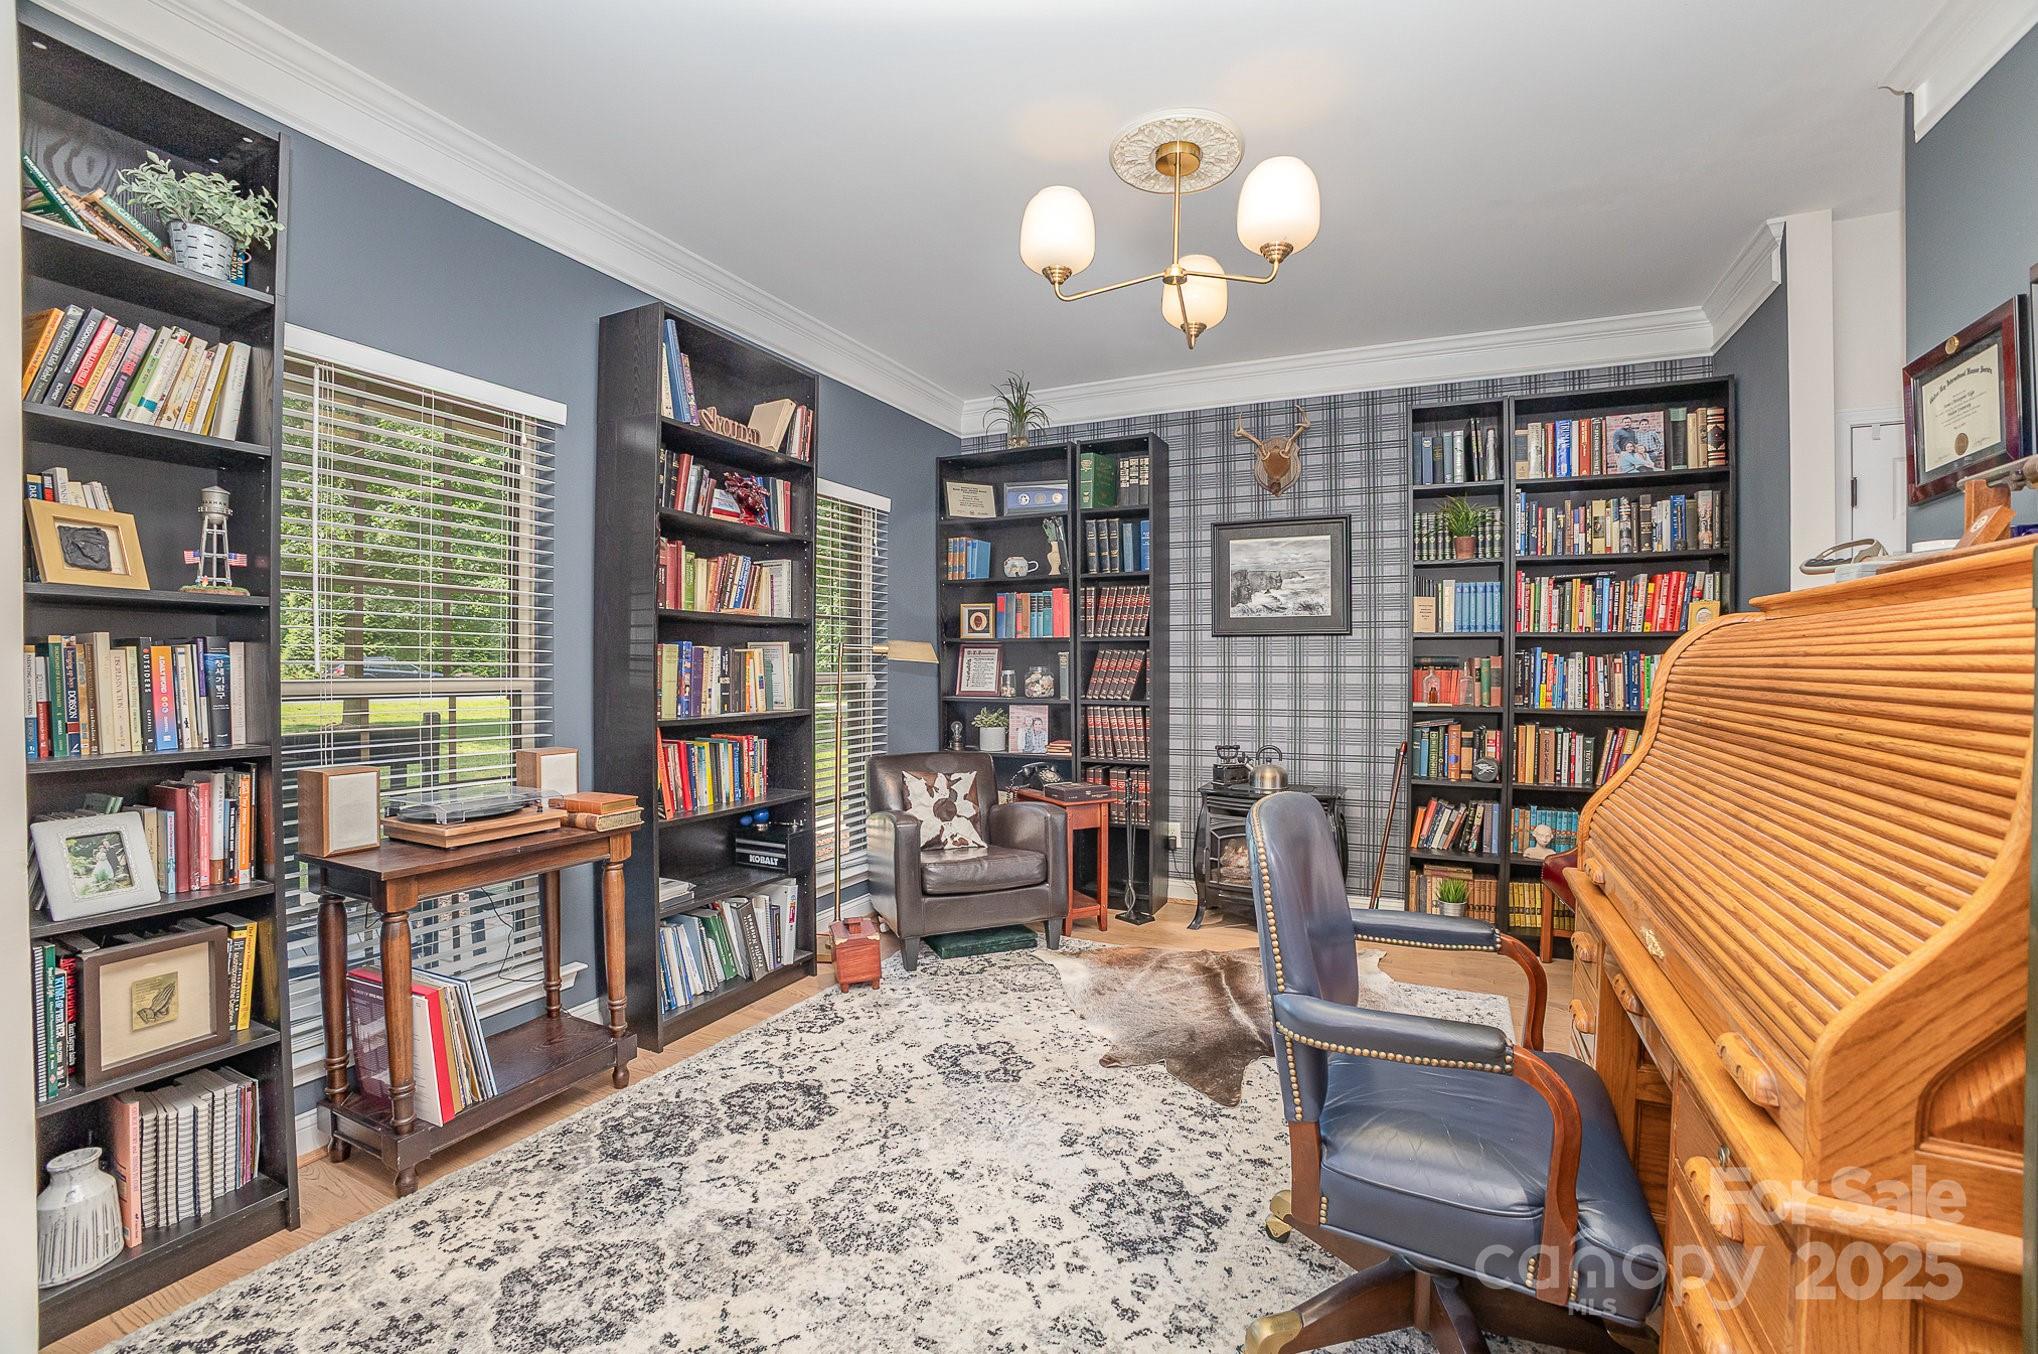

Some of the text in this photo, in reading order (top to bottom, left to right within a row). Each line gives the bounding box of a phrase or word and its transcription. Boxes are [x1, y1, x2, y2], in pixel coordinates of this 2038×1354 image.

[51, 328, 70, 355] Christian
[68, 690, 77, 719] DOBSON
[750, 854, 778, 866] KOBALT
[231, 952, 239, 982] Mushrooms
